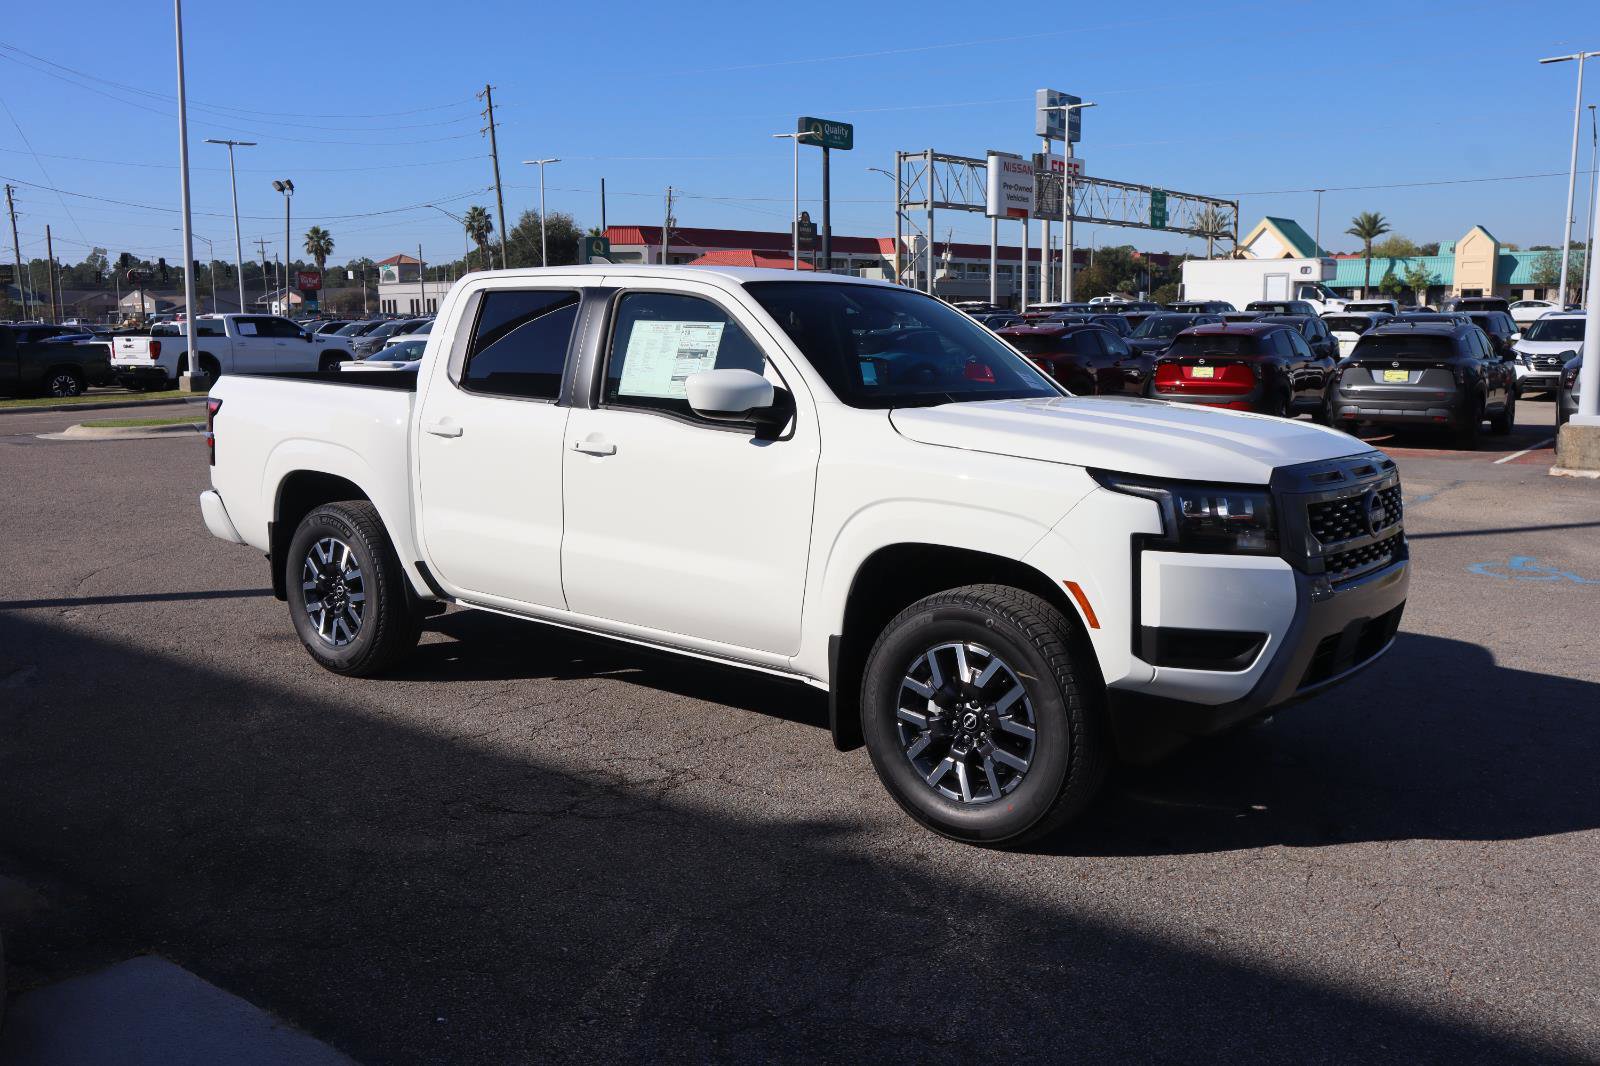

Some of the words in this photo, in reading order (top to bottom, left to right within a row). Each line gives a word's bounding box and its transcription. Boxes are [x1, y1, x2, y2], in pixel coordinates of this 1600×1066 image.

[824, 123, 849, 138] Quality
[1003, 161, 1033, 176] NISSAN
[1002, 182, 1033, 193] Pre-Owned
[1006, 193, 1030, 203] Vehicles
[592, 240, 605, 256] Q
